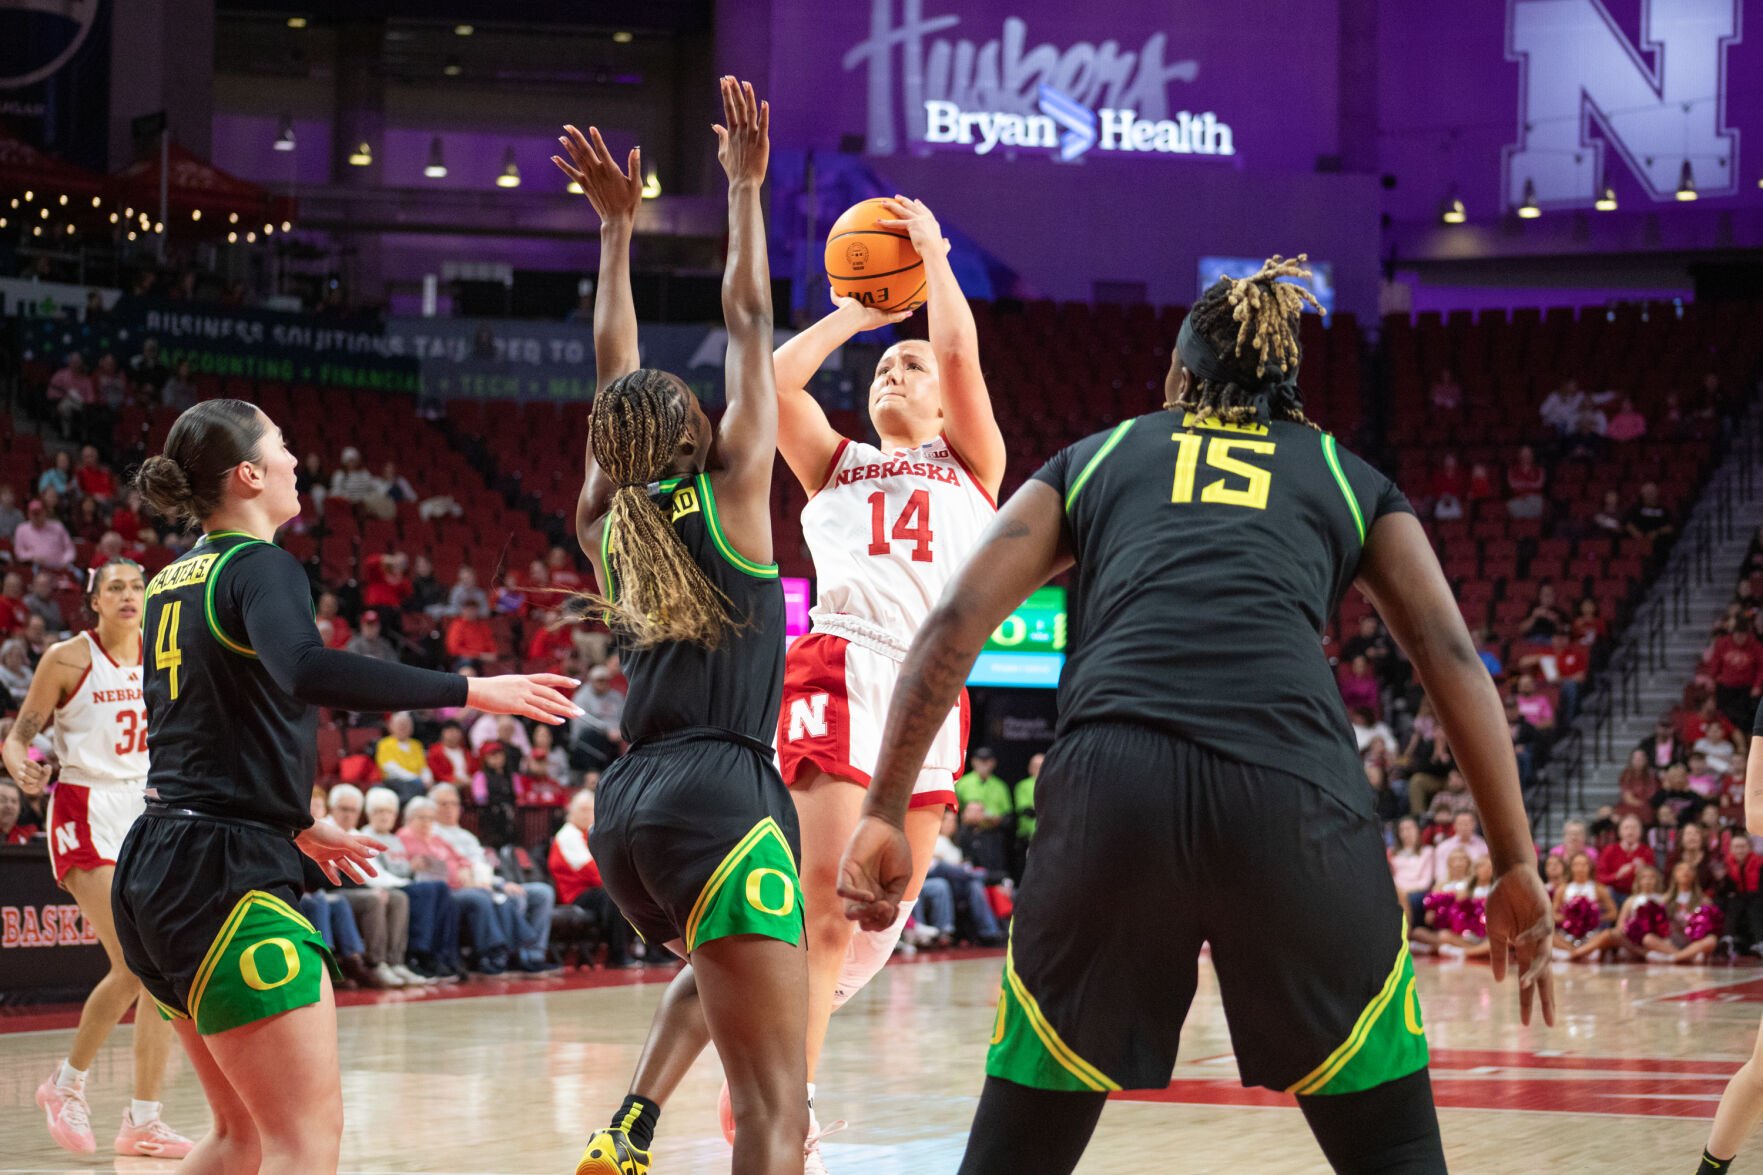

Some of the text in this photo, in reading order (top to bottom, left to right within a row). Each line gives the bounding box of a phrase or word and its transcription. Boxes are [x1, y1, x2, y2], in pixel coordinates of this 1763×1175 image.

[924, 100, 1235, 155] Bryan Health
[834, 460, 961, 489] NEBRASKA
[1171, 431, 1277, 510] 15
[867, 489, 934, 563] 14
[155, 600, 182, 701] 4
[788, 692, 830, 744] N
[55, 820, 80, 856] N
[744, 867, 795, 917] O
[239, 937, 301, 991] O
